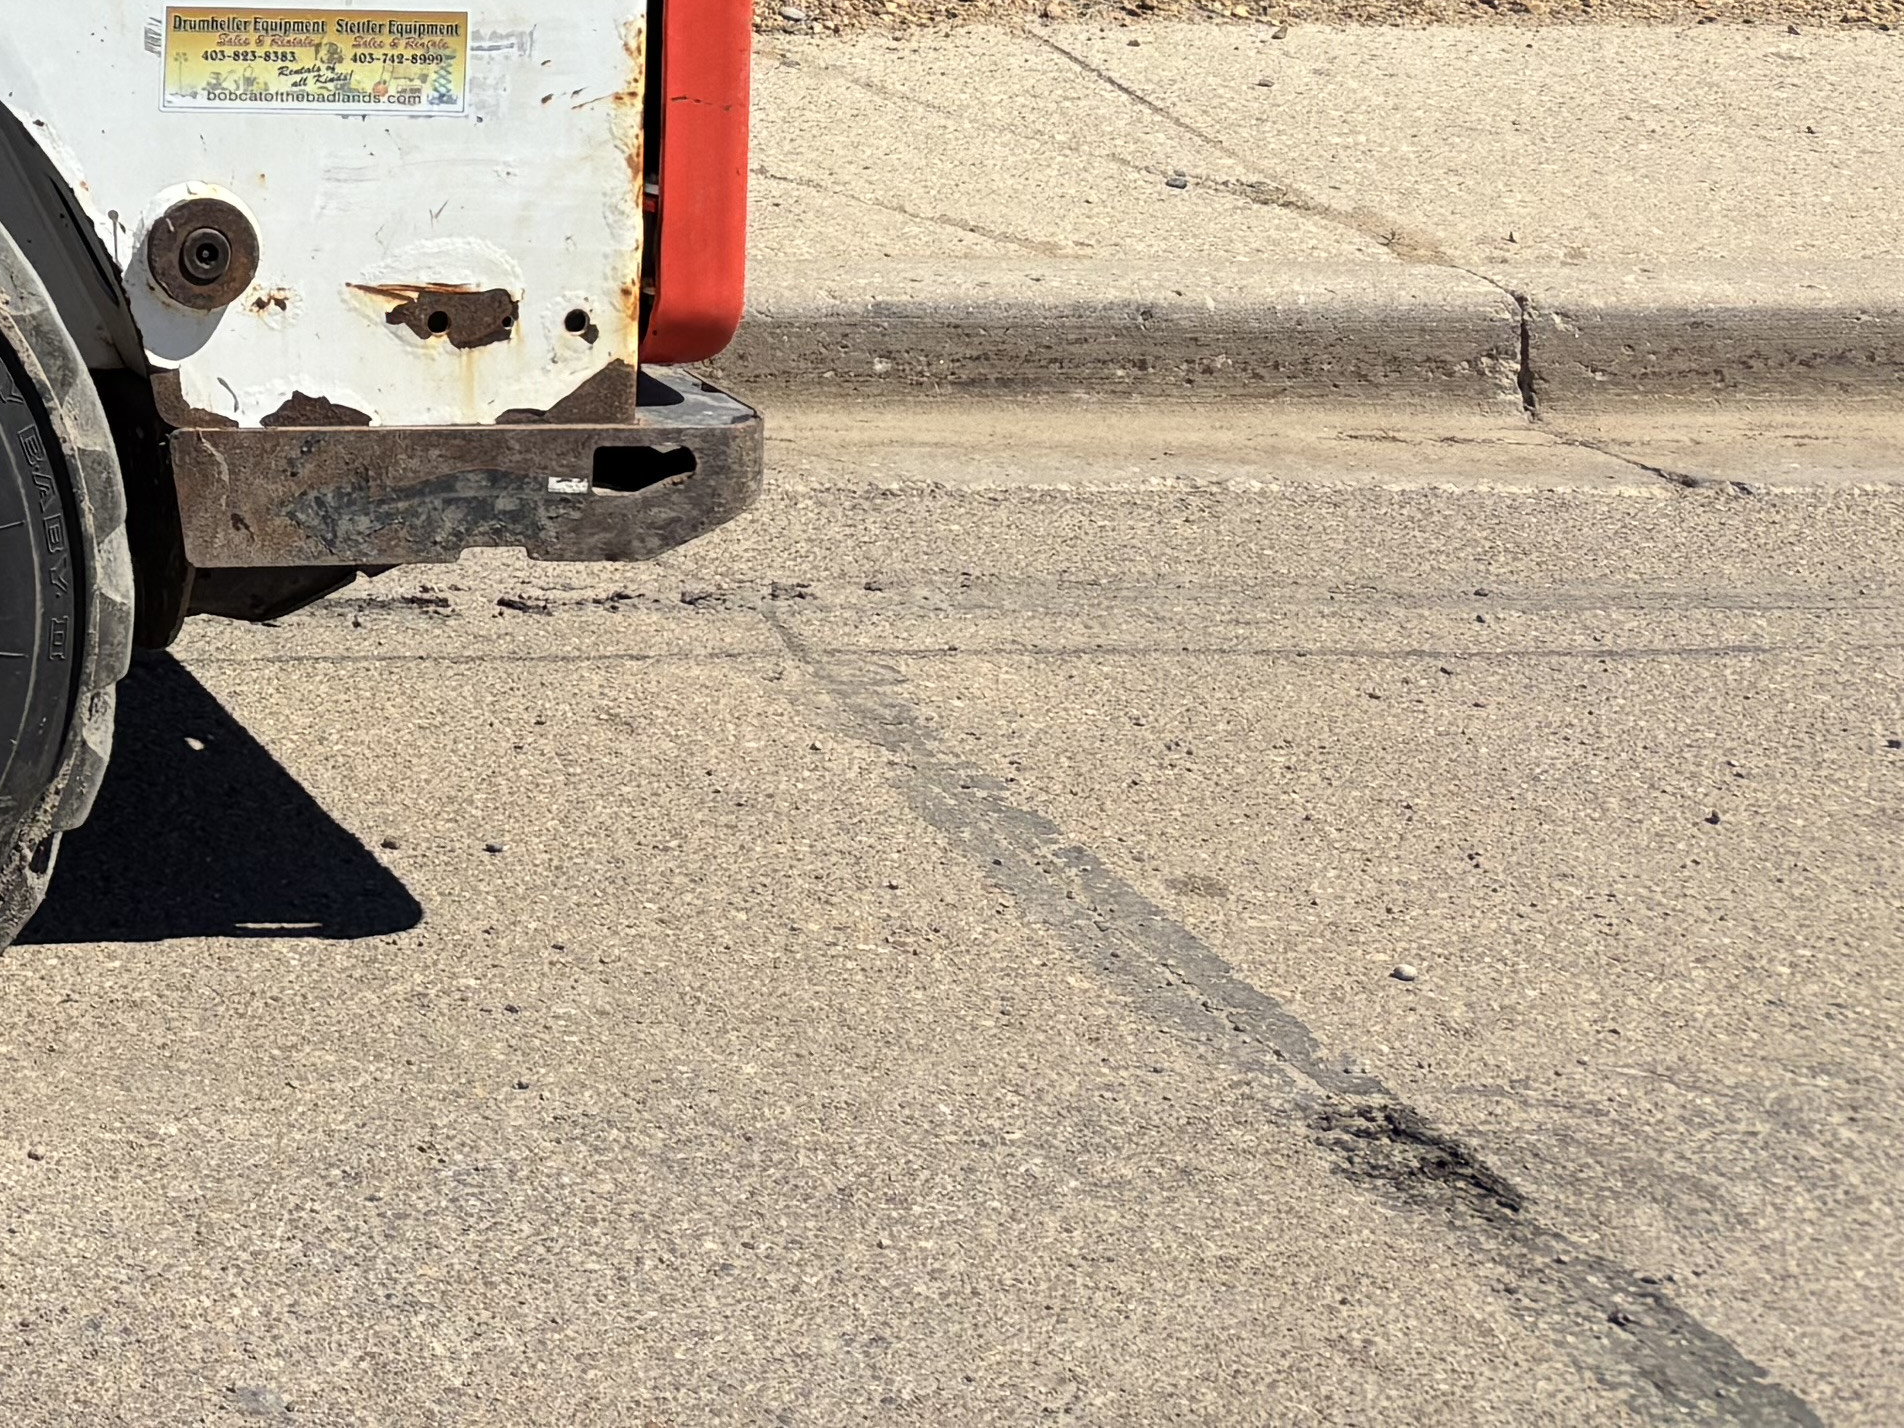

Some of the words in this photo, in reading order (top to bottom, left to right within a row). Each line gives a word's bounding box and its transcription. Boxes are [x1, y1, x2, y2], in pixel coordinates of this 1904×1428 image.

[173, 15, 249, 31] Drumheller
[253, 17, 327, 34] Equipment
[388, 20, 460, 37] Equipment
[278, 64, 322, 77] Rentals
